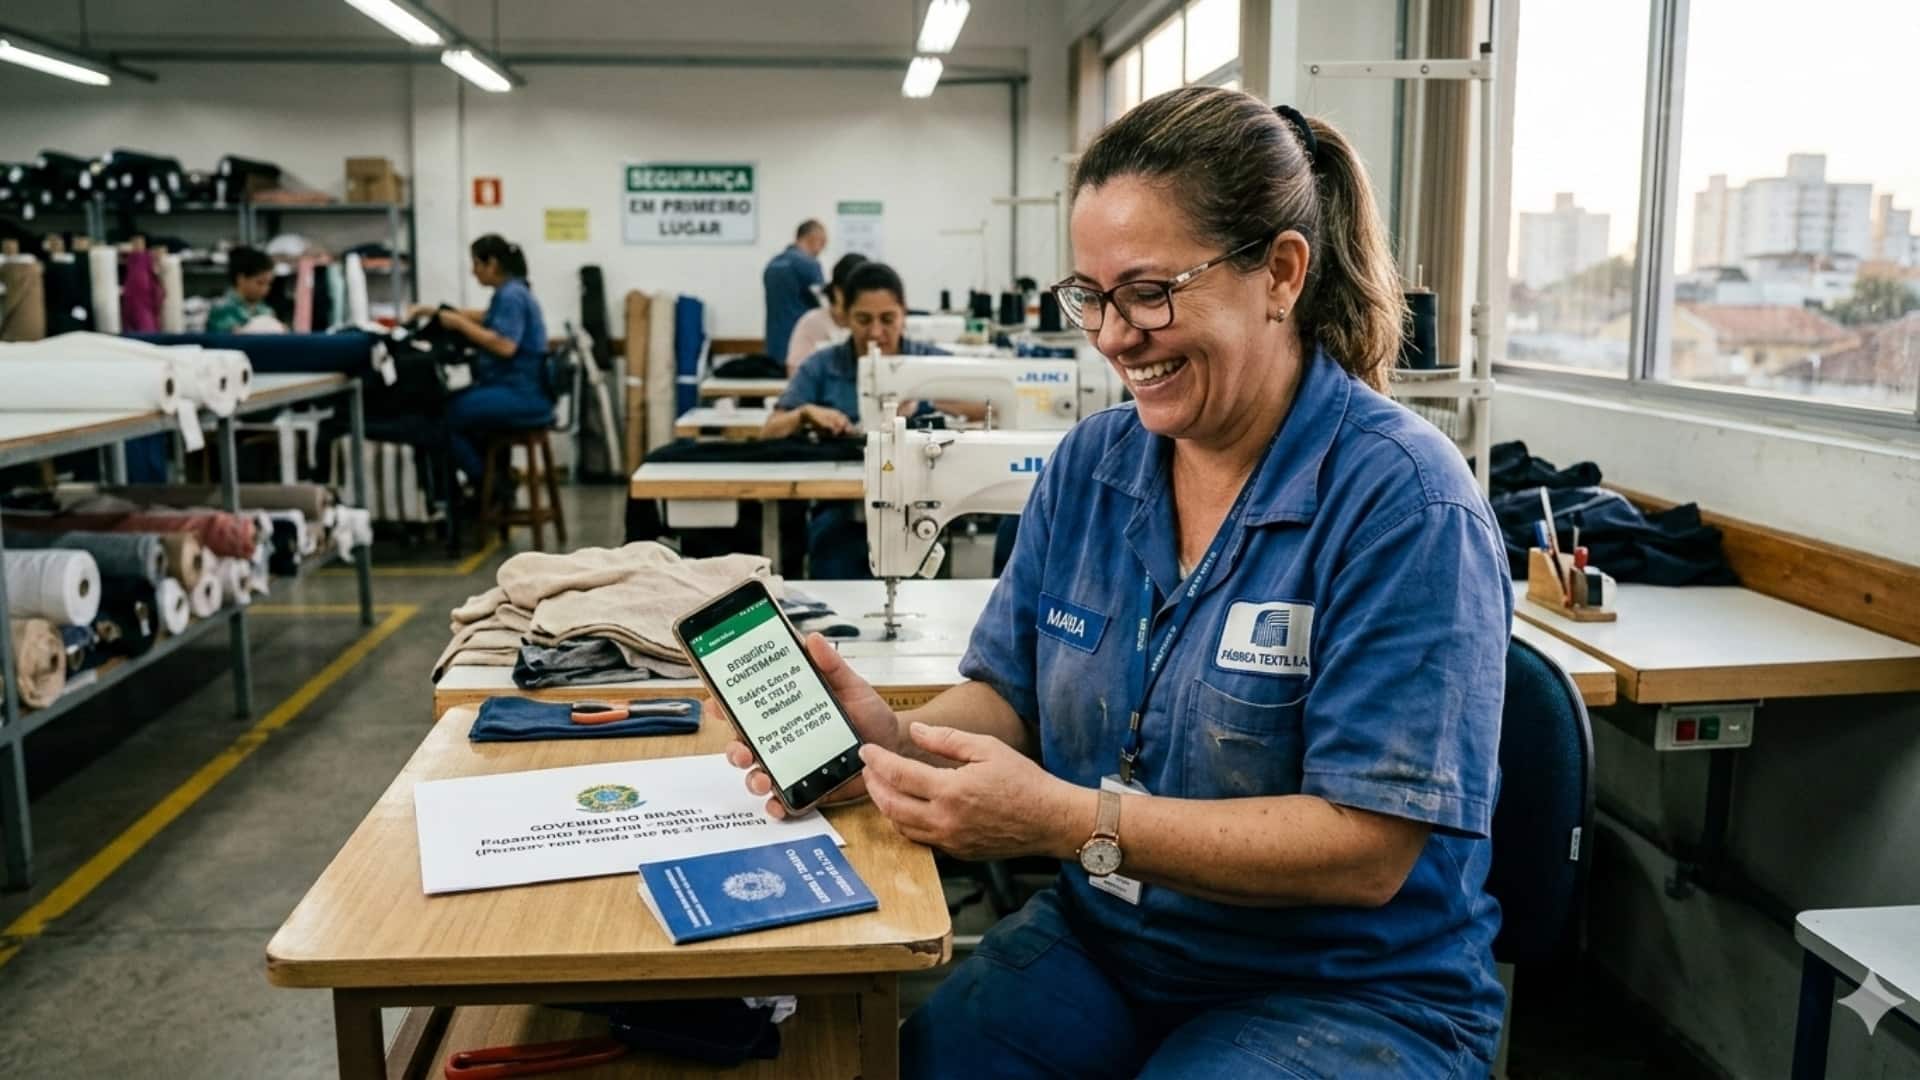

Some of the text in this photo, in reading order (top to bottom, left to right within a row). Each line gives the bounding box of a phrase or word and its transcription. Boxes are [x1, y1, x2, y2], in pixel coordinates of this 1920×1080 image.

[630, 168, 750, 192] SEGURANÇA
[630, 199, 752, 215] EM PRIMEIRO
[659, 220, 721, 236] LUGAR
[1017, 371, 1070, 382] JUKI
